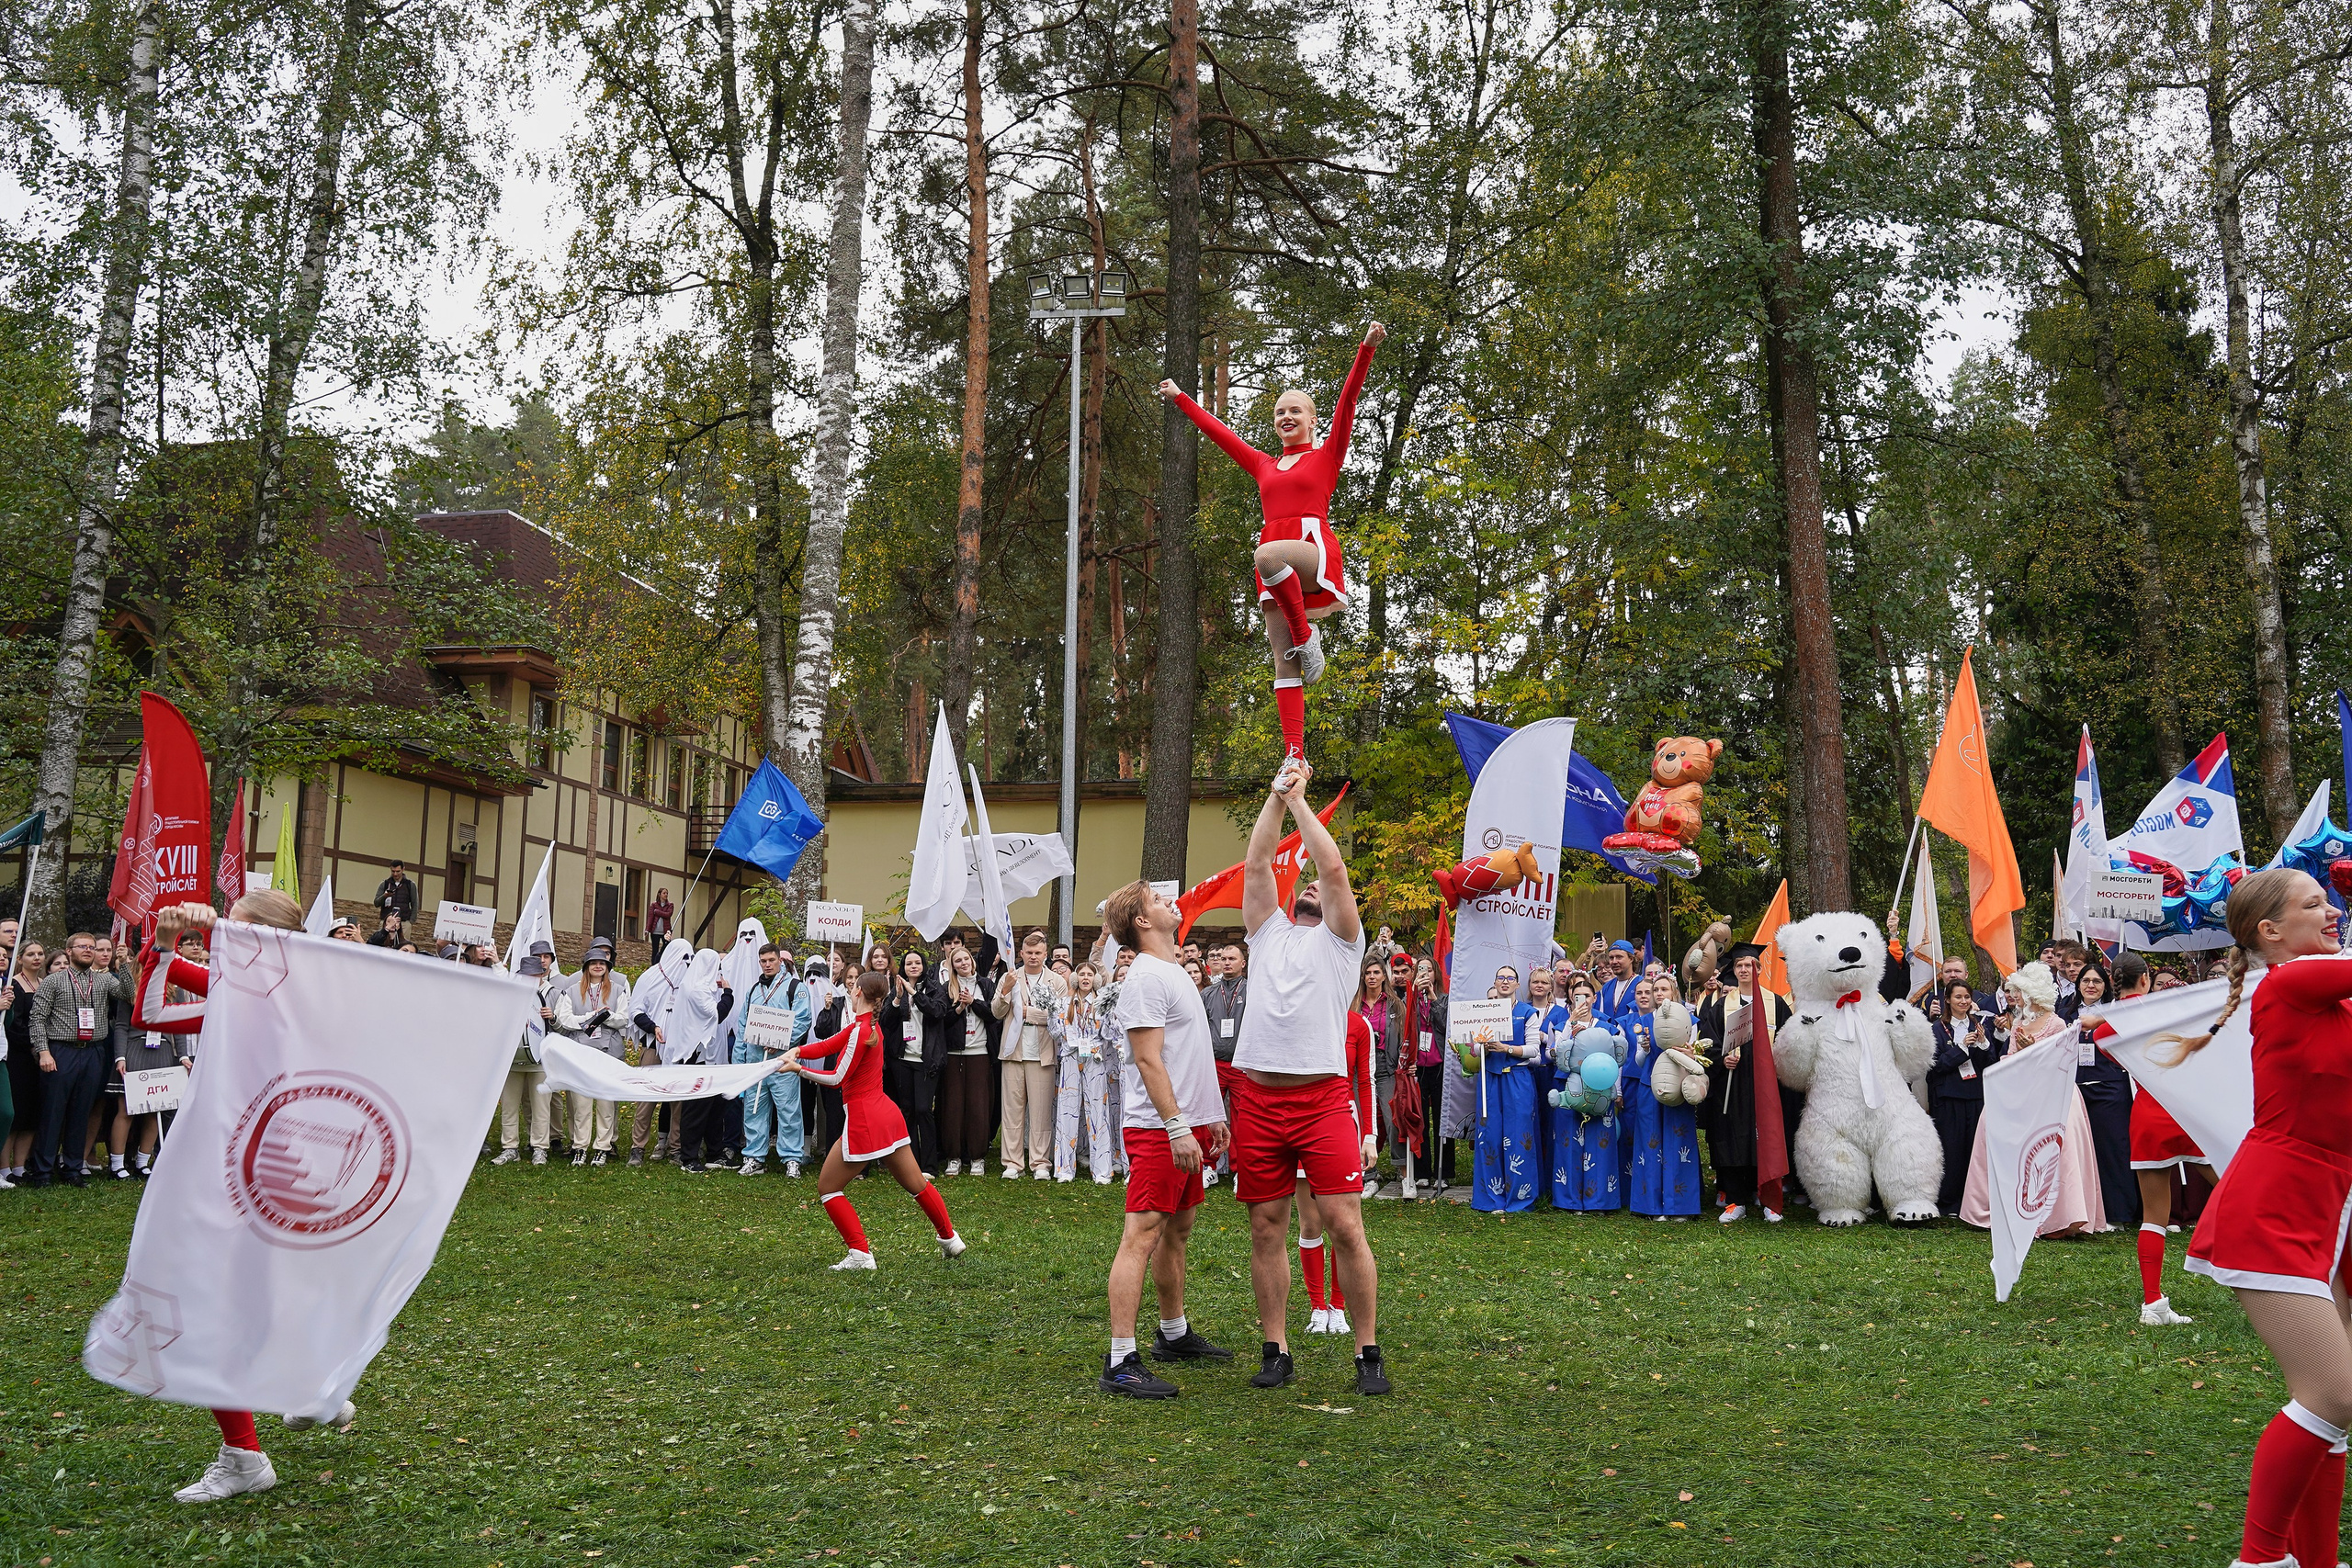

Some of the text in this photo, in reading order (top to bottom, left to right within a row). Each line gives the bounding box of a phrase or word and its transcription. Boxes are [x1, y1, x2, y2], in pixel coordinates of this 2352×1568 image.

[764, 805, 777, 815] CG
[1644, 803, 1661, 813] you
[156, 875, 198, 895] ТРОЙСЛЁТ
[2097, 891, 2155, 901] МОСГОРБТИ
[1476, 899, 1552, 920] СТРОЙСЛЁТ
[818, 917, 852, 927] КОЛДИ
[750, 1021, 775, 1030] КАПИТАЛ
[1453, 1017, 1510, 1025] МОНАРХ-ПРОЕКТ
[147, 1085, 168, 1096] ДГИ
